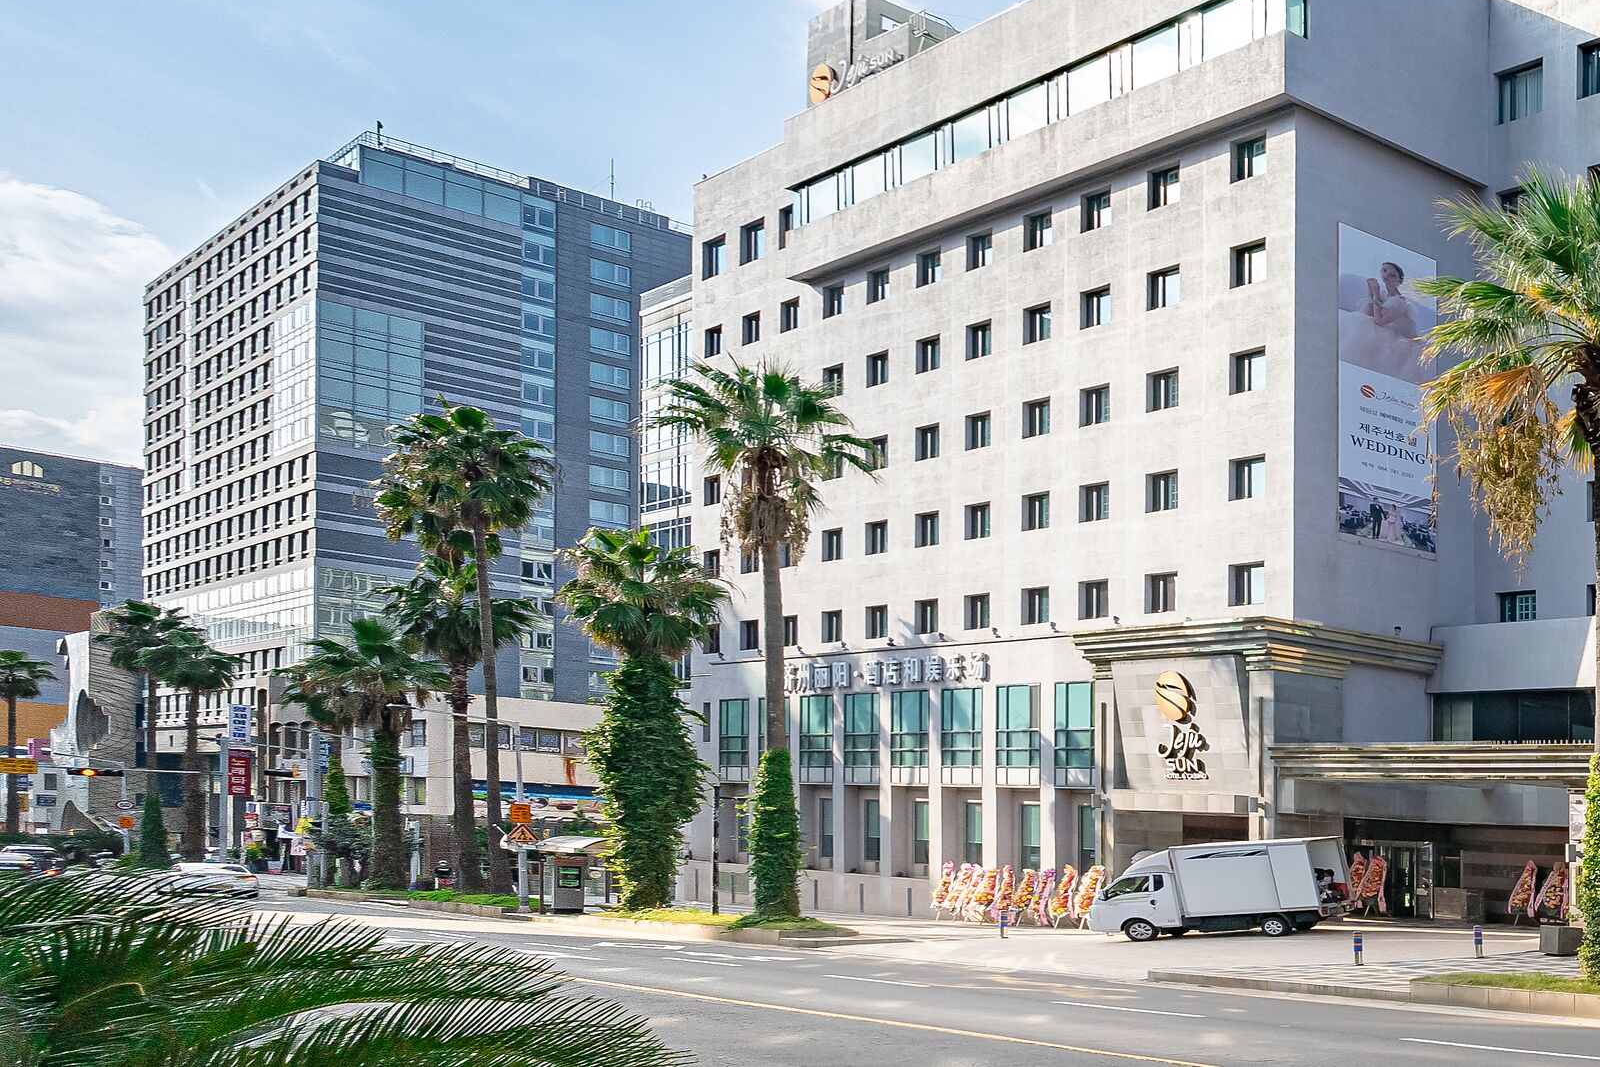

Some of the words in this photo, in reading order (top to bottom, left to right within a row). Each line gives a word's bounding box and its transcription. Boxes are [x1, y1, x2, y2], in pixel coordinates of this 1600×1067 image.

[831, 54, 869, 94] Jeju
[1350, 434, 1426, 465] WEDDING
[1157, 722, 1203, 758] Jeju
[1166, 758, 1199, 772] SUN
